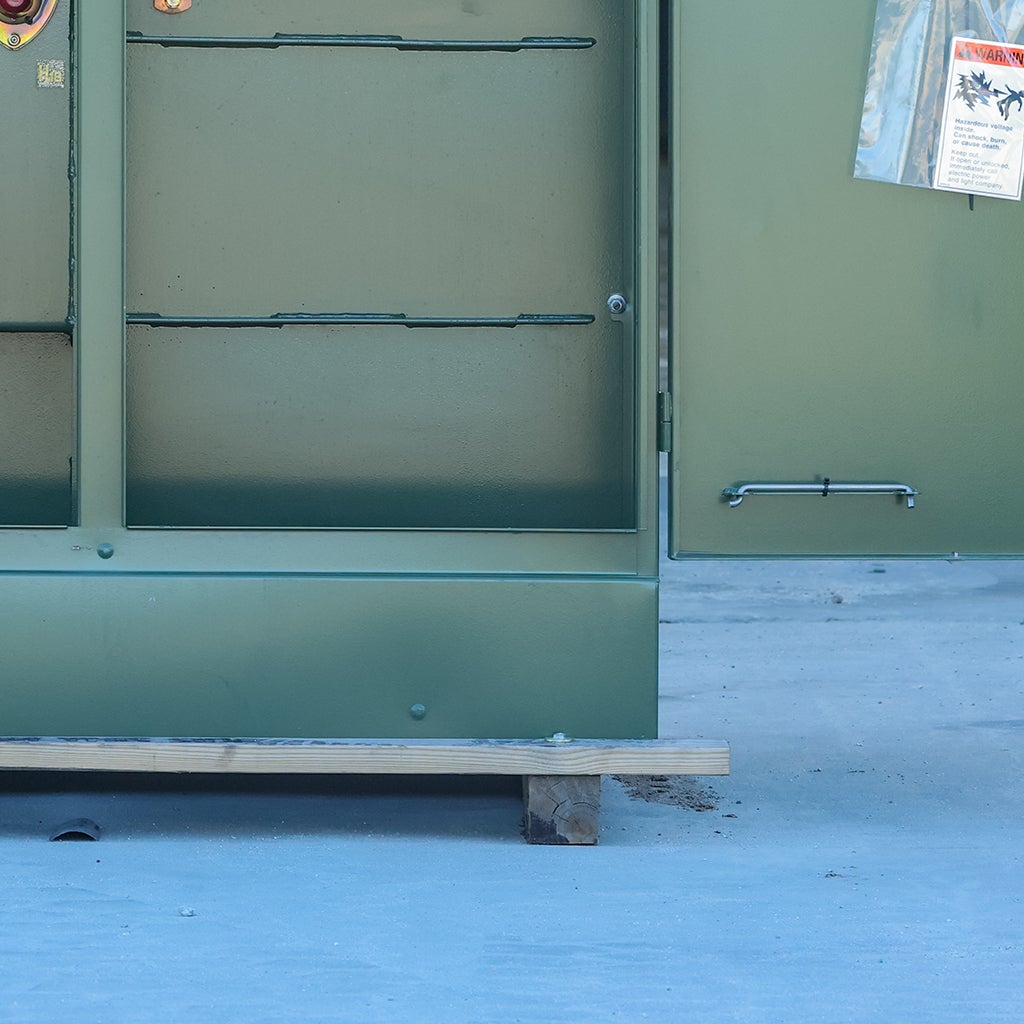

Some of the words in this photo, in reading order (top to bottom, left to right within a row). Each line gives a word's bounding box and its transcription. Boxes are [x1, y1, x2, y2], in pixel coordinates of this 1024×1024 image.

[954, 125, 975, 133] inside.
[955, 118, 989, 128] Hazardous
[990, 123, 1013, 132] voltage
[953, 131, 967, 139] Can
[989, 136, 1007, 144] burn,
[960, 139, 980, 147] cause
[951, 149, 968, 157] Keep
[956, 157, 972, 165] open
[949, 163, 985, 174] immediately
[948, 169, 971, 177] electric
[971, 173, 992, 181] power
[947, 176, 960, 184] and
[960, 178, 974, 187] light
